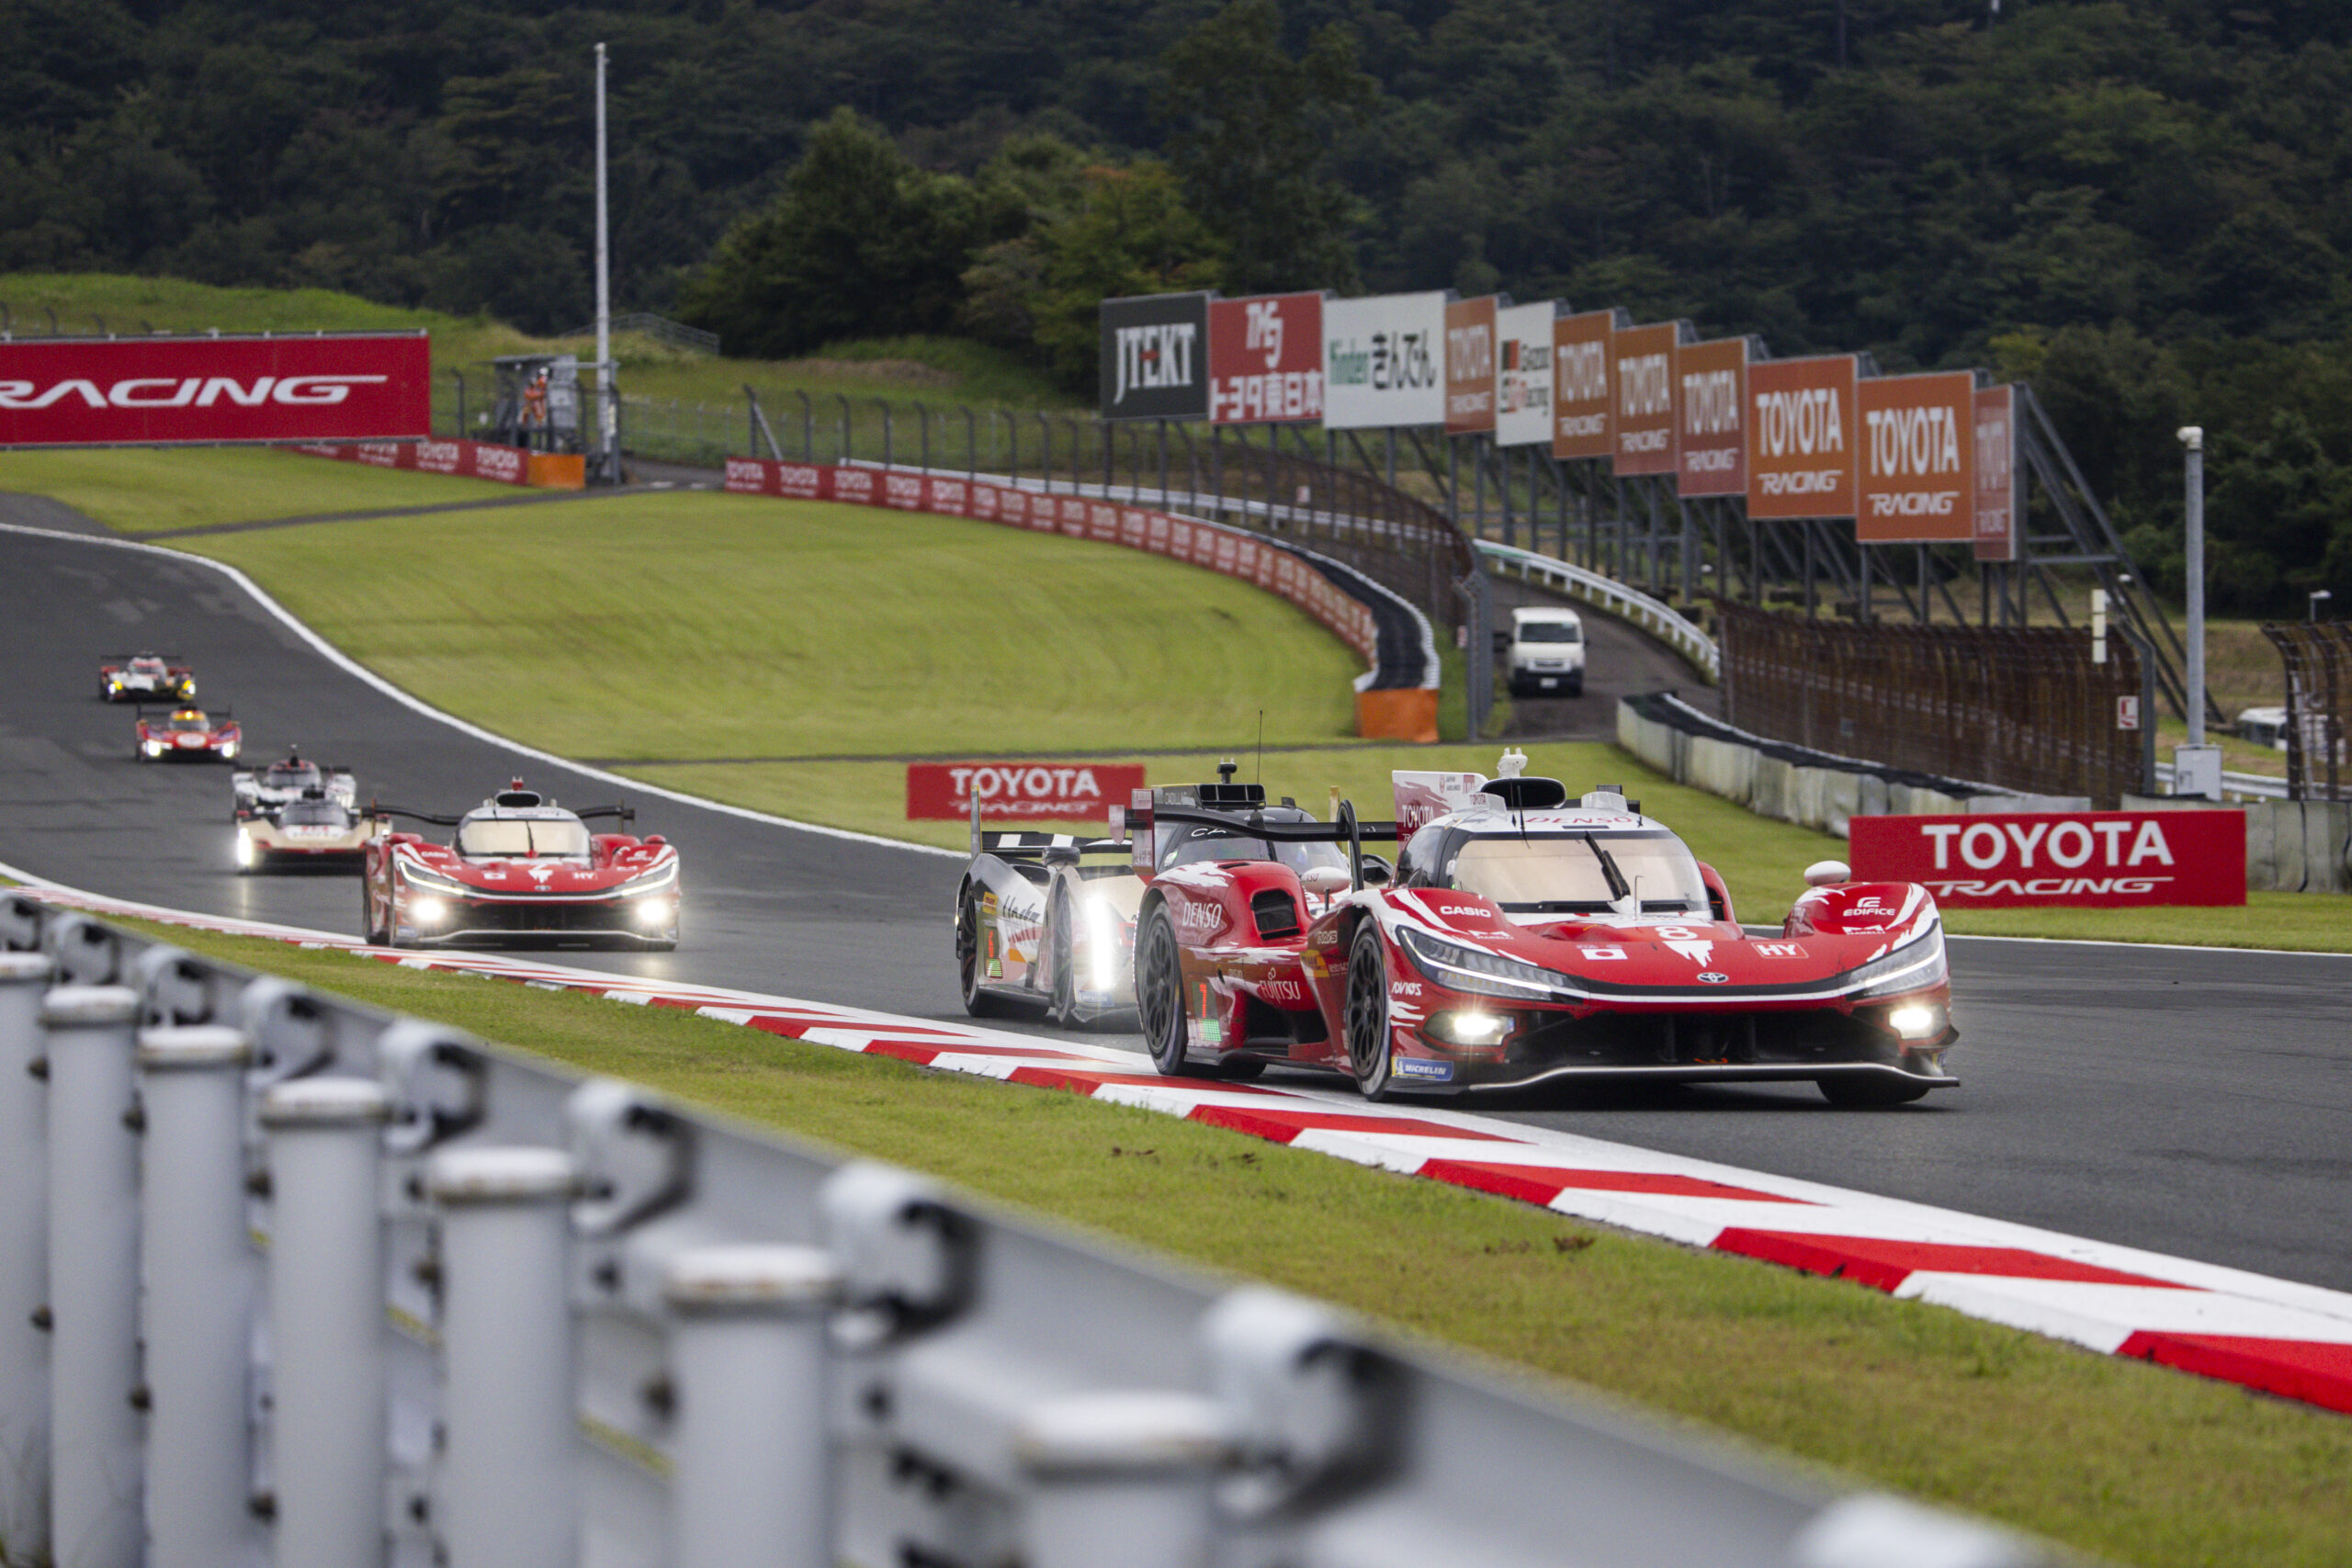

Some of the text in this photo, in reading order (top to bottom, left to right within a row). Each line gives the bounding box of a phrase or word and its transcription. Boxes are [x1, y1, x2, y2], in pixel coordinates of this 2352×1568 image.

[1114, 322, 1195, 404] JTEKT
[1371, 328, 1437, 390] きんでん
[1558, 340, 1607, 402] TOYOTA
[1209, 370, 1323, 421] トヨタ東日本
[1618, 353, 1671, 417] TOYOTA
[1683, 369, 1739, 435] TOYOTA
[1756, 387, 1844, 457] TOYOTA
[1620, 428, 1671, 453] RACING
[1866, 406, 1961, 478] TOYOTA
[1684, 447, 1739, 472] RACING
[1756, 468, 1844, 495] RACING
[1867, 491, 1961, 517] RACING
[949, 768, 1101, 798] TOYOTA
[1402, 805, 1434, 829] TOYOTA
[1922, 820, 2175, 871] TOYOTA
[1922, 875, 2175, 897] RACING
[1182, 902, 1222, 929] DENSO
[1440, 906, 1492, 918] CASIO
[1843, 908, 1896, 917] EDIFICE
[1317, 930, 1338, 944] RAYS
[1655, 926, 1699, 941] 8
[1758, 942, 1797, 957] HY
[1259, 979, 1301, 1004] FUJITSU
[1405, 1064, 1447, 1075] MICHELIN
